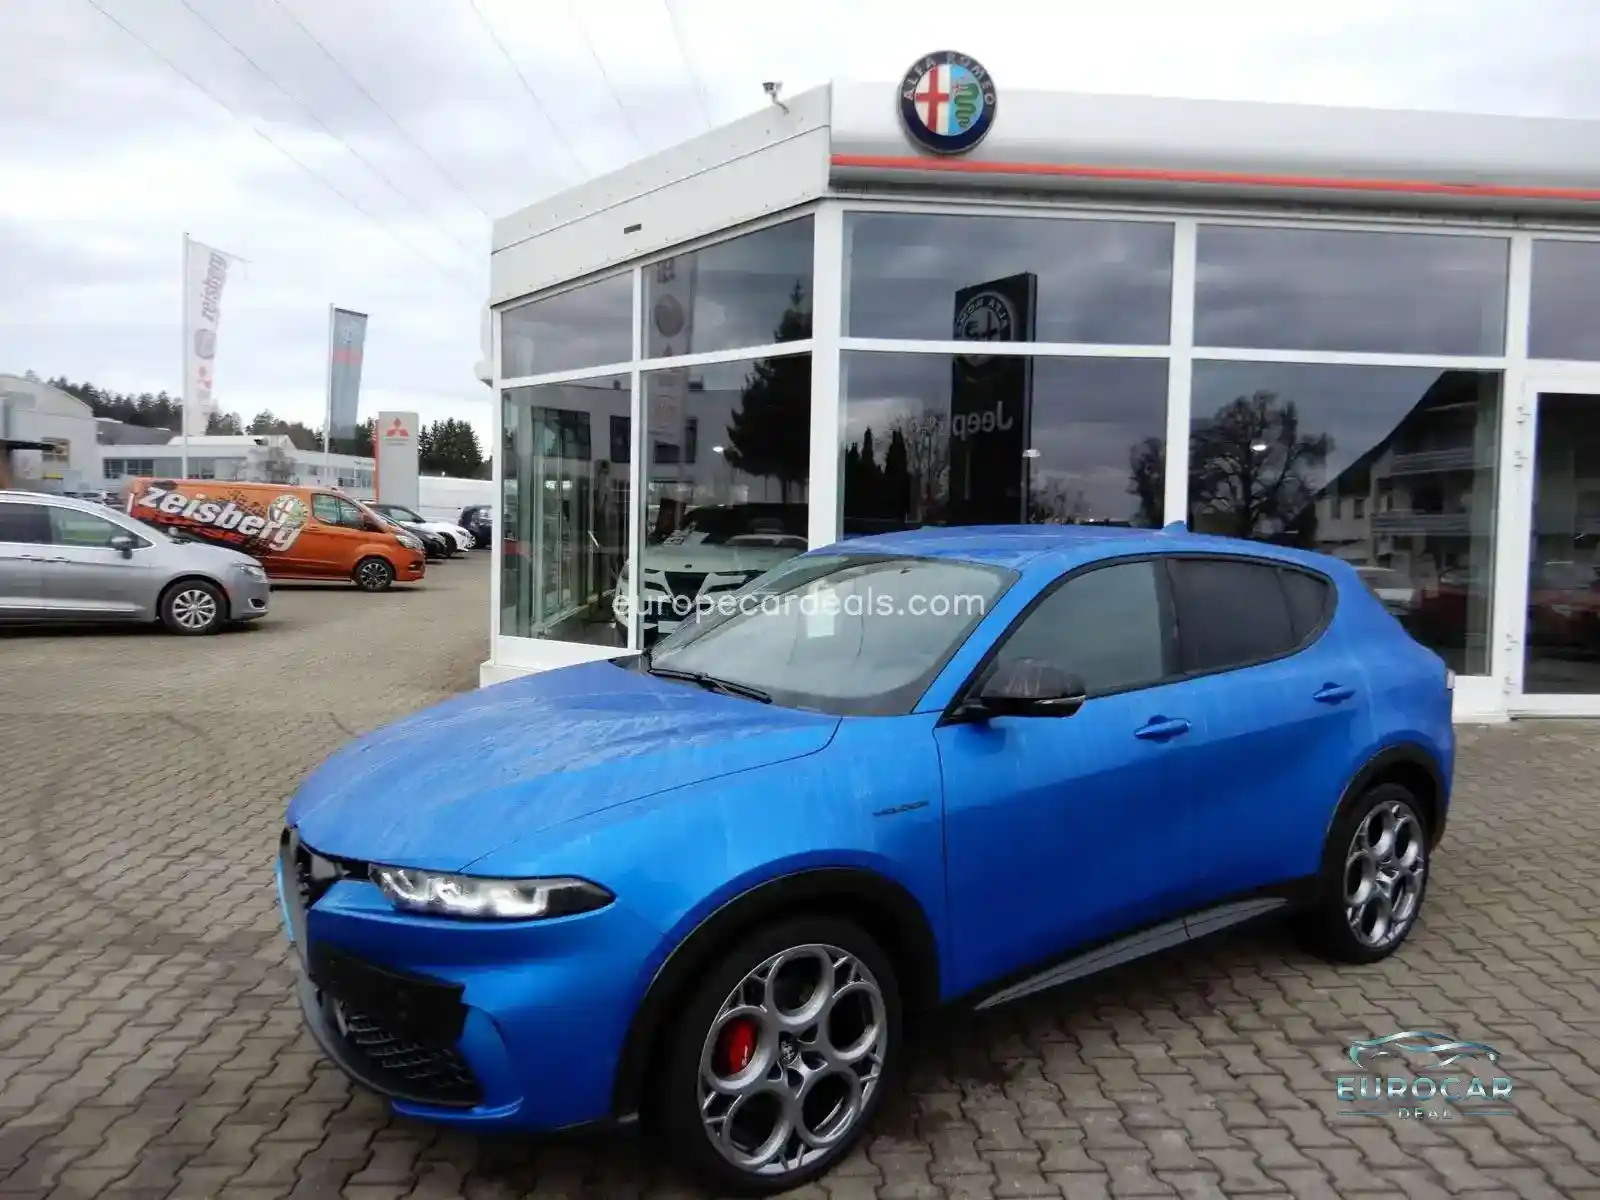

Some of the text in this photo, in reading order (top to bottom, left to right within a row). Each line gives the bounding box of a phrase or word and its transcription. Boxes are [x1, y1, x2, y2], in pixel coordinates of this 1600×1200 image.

[903, 52, 995, 105] ALFA ROMEO
[138, 486, 301, 551] zeisberg
